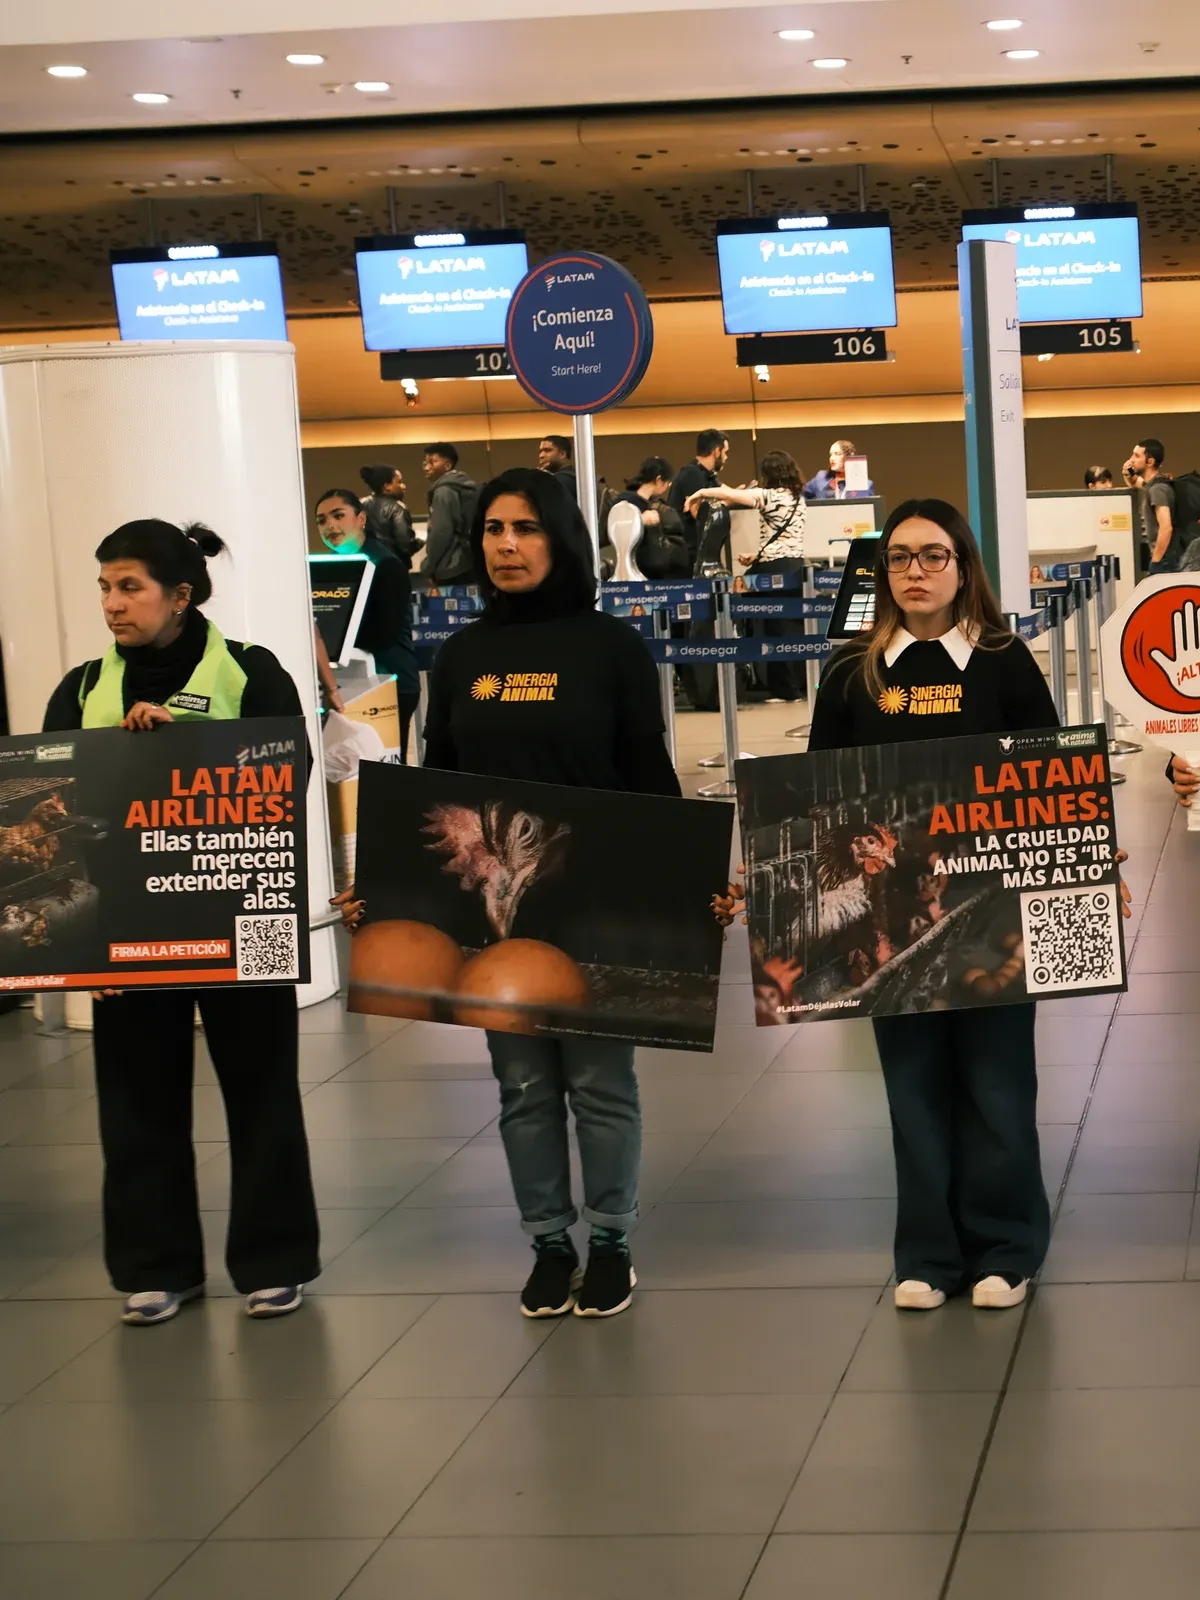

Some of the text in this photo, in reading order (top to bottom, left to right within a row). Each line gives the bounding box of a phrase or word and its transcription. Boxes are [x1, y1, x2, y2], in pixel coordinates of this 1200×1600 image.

[1024, 231, 1096, 247] LATAM
[778, 240, 849, 256] LATAM
[416, 257, 486, 274] LATAM
[172, 269, 239, 286] LATAM
[557, 272, 595, 283] LATAM
[532, 308, 614, 332] ¡Comienza
[554, 331, 595, 354] Aquí!
[832, 337, 876, 356] 106
[1078, 328, 1122, 348] 105
[551, 363, 602, 376] Start Here!
[1001, 410, 1014, 422] Exit
[737, 604, 783, 614] despegar
[680, 642, 832, 657] despegar despegar
[504, 672, 558, 687] SINERGIA
[500, 686, 555, 702] ANIMAL
[910, 684, 962, 700] SINERGIA
[908, 698, 961, 714] ANIMAL
[1145, 720, 1177, 734] ANIMALES
[1178, 718, 1198, 734] LIBRES
[1070, 732, 1095, 740] anima
[1070, 738, 1096, 746] naturalis
[252, 740, 295, 759] LATAM
[172, 764, 292, 796] LATAM
[974, 754, 1104, 794] LATAM
[124, 794, 294, 828] AIRLINES:
[928, 791, 1110, 835] AIRLINES:
[140, 826, 294, 852] Ellas también
[975, 825, 1110, 852] LA CRUELDAD
[192, 851, 294, 870] merecen
[933, 844, 1112, 876] ANIMAL NO ES “IR
[146, 867, 296, 892] extender sus
[1003, 863, 1112, 888] MÁS ALTO”
[243, 888, 296, 910] alas.
[112, 940, 226, 958] FIRMA LA PETICIÓN
[776, 998, 860, 1013] #LatamDéjalasVolar
